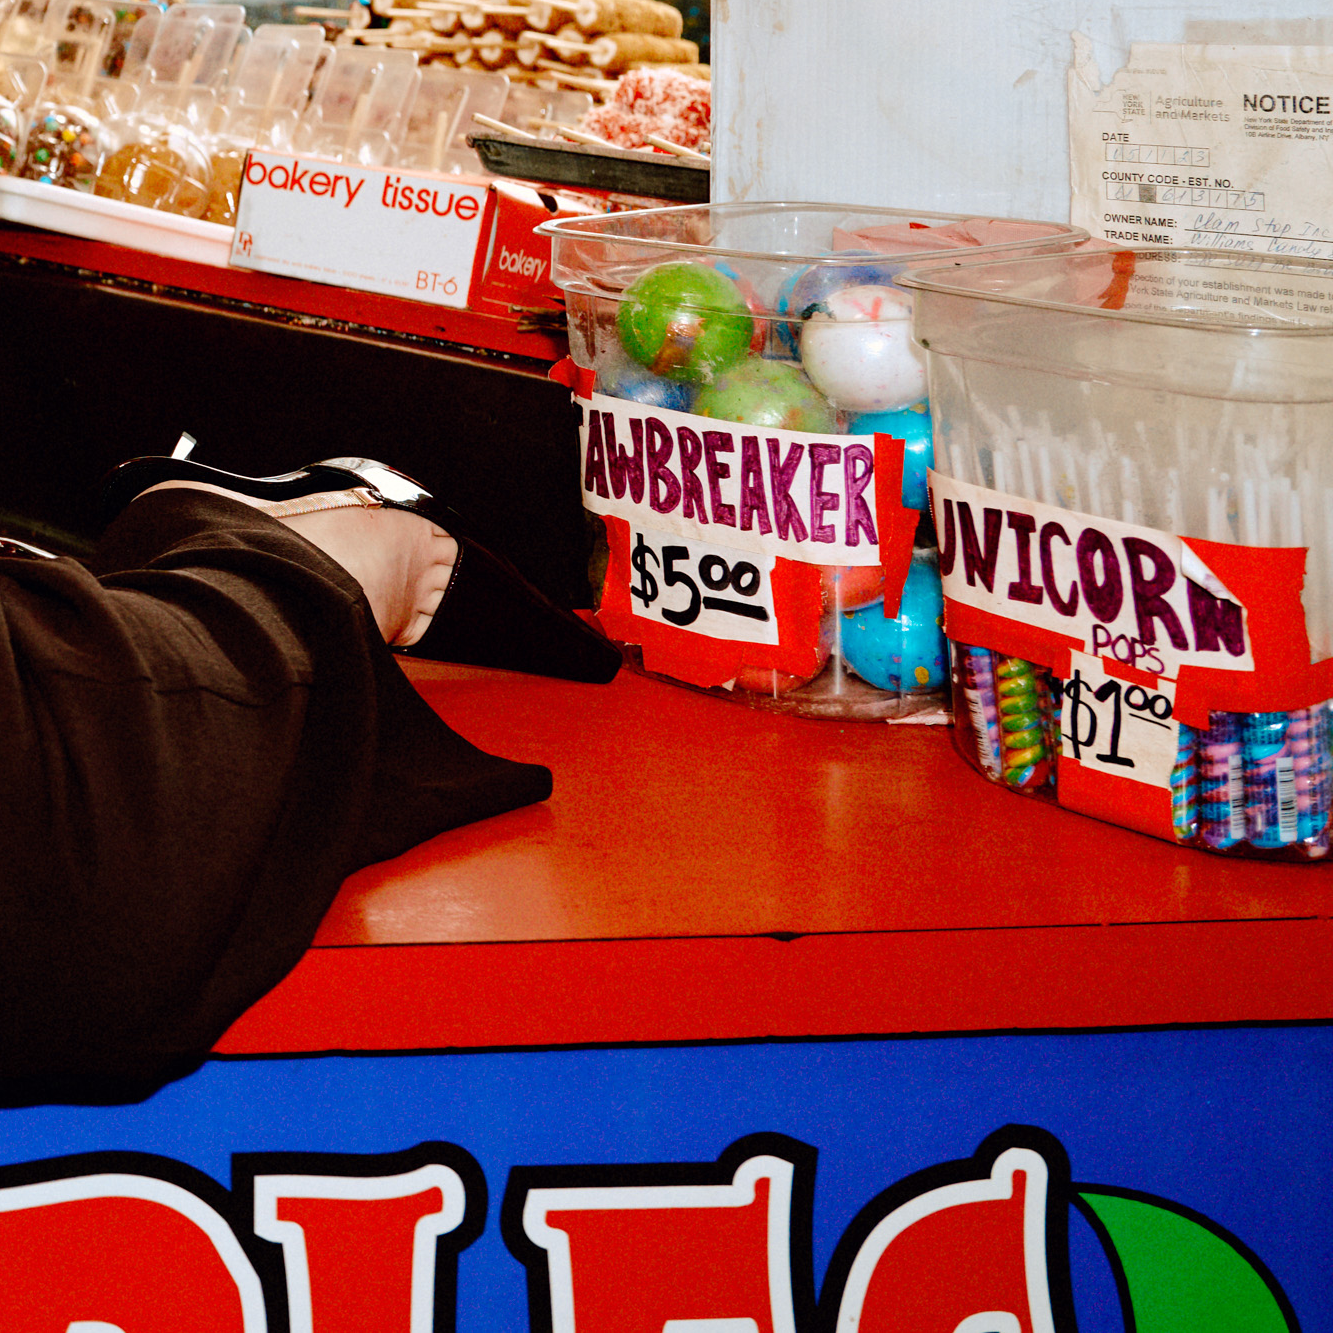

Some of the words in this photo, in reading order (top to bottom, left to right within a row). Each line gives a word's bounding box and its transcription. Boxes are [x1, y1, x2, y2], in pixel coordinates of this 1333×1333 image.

[1122, 108, 1146, 117] STATE
[1154, 94, 1224, 110] Agriculture
[1243, 93, 1331, 115] NOTICE
[1154, 109, 1177, 120] and
[1179, 108, 1231, 123] Markets
[1290, 118, 1325, 126] Department
[1101, 132, 1130, 143] DATE
[1291, 125, 1310, 134] Safety
[245, 153, 365, 209] bakery
[381, 176, 481, 221] tissue
[1101, 171, 1145, 182] COUNTY
[1147, 173, 1180, 185] CODE
[1188, 178, 1213, 188] EST.
[1214, 178, 1235, 189] NO.
[1103, 213, 1143, 225] OWNER
[1144, 216, 1178, 229] NAME:
[1192, 212, 1240, 232] Clam
[1254, 217, 1291, 237] Stop
[1104, 229, 1140, 241] TRADE
[1141, 232, 1174, 245] NAME:
[1190, 233, 1254, 252] Williams
[1267, 237, 1323, 259] Candy
[498, 244, 548, 284] bakery
[414, 270, 459, 297] BT-6
[1165, 276, 1176, 285] of
[1177, 278, 1200, 288] your
[1201, 280, 1272, 295] establishment
[1273, 287, 1295, 297] was
[1297, 290, 1325, 300] made
[1151, 287, 1173, 298] State
[1175, 290, 1229, 303] Agriculture
[1231, 296, 1251, 306] and
[1253, 297, 1294, 310] Markets
[1296, 301, 1318, 313] Law
[585, 409, 879, 548] AWBREAKER
[1092, 623, 1166, 675] POPS
